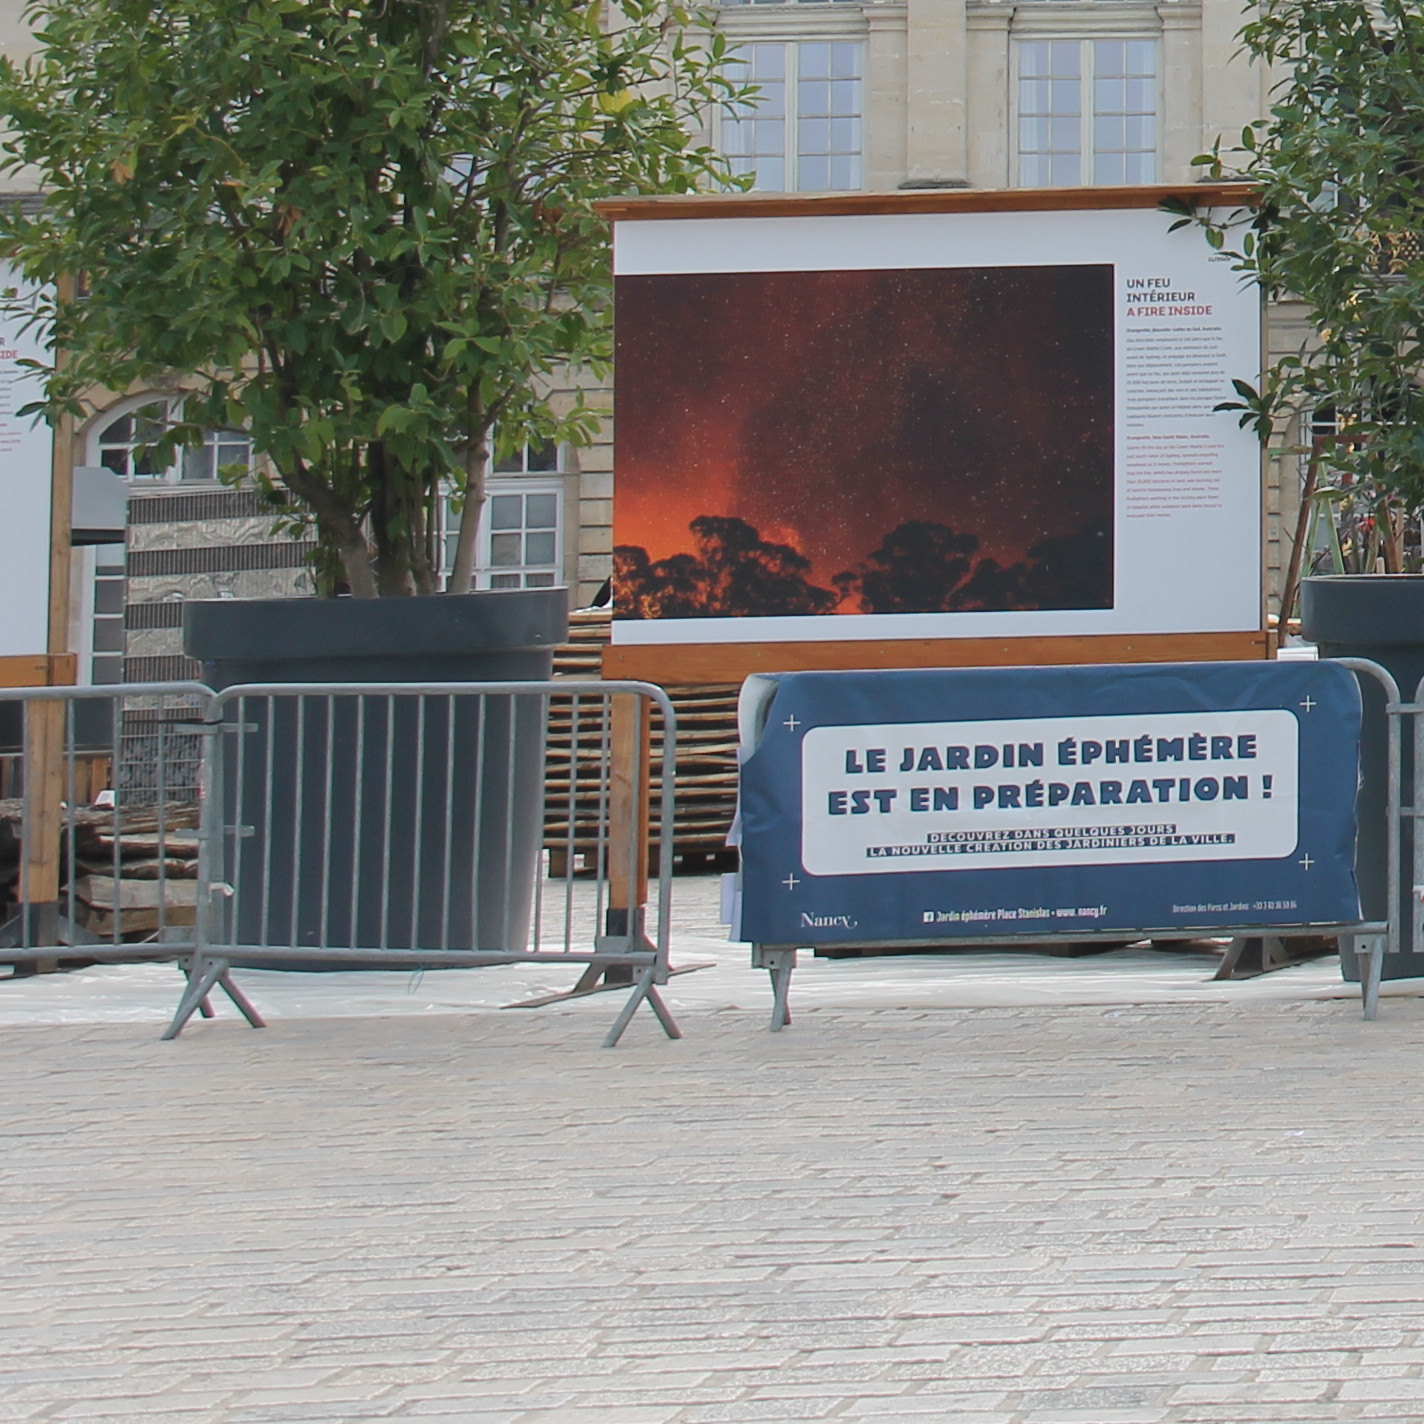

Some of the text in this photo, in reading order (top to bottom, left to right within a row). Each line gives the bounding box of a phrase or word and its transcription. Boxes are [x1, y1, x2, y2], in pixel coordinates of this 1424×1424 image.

[1126, 277, 1171, 289] UN FEU
[1126, 289, 1196, 303] INTÉRIEUR
[1126, 305, 1213, 317] A FIRE INSIDE
[845, 732, 1257, 774] LE JARDIN ÉPHÉMÈRE
[828, 788, 898, 815] EST
[910, 785, 959, 812] EN
[972, 774, 1249, 810] PRÉPARATION
[1014, 827, 1050, 840] DANS
[1054, 825, 1130, 838] QUELQUES
[1130, 824, 1174, 836] JOURS
[869, 846, 888, 857] LA
[891, 843, 962, 856] NOUVELLE
[1037, 839, 1061, 851] DES
[1066, 836, 1145, 849] JARDINIERS
[1149, 835, 1166, 846] DE
[1171, 835, 1188, 845] LA
[936, 910, 960, 922] Jardin
[961, 909, 996, 923] éphémère
[997, 908, 1017, 921] Place
[1018, 907, 1050, 919] Stanislas
